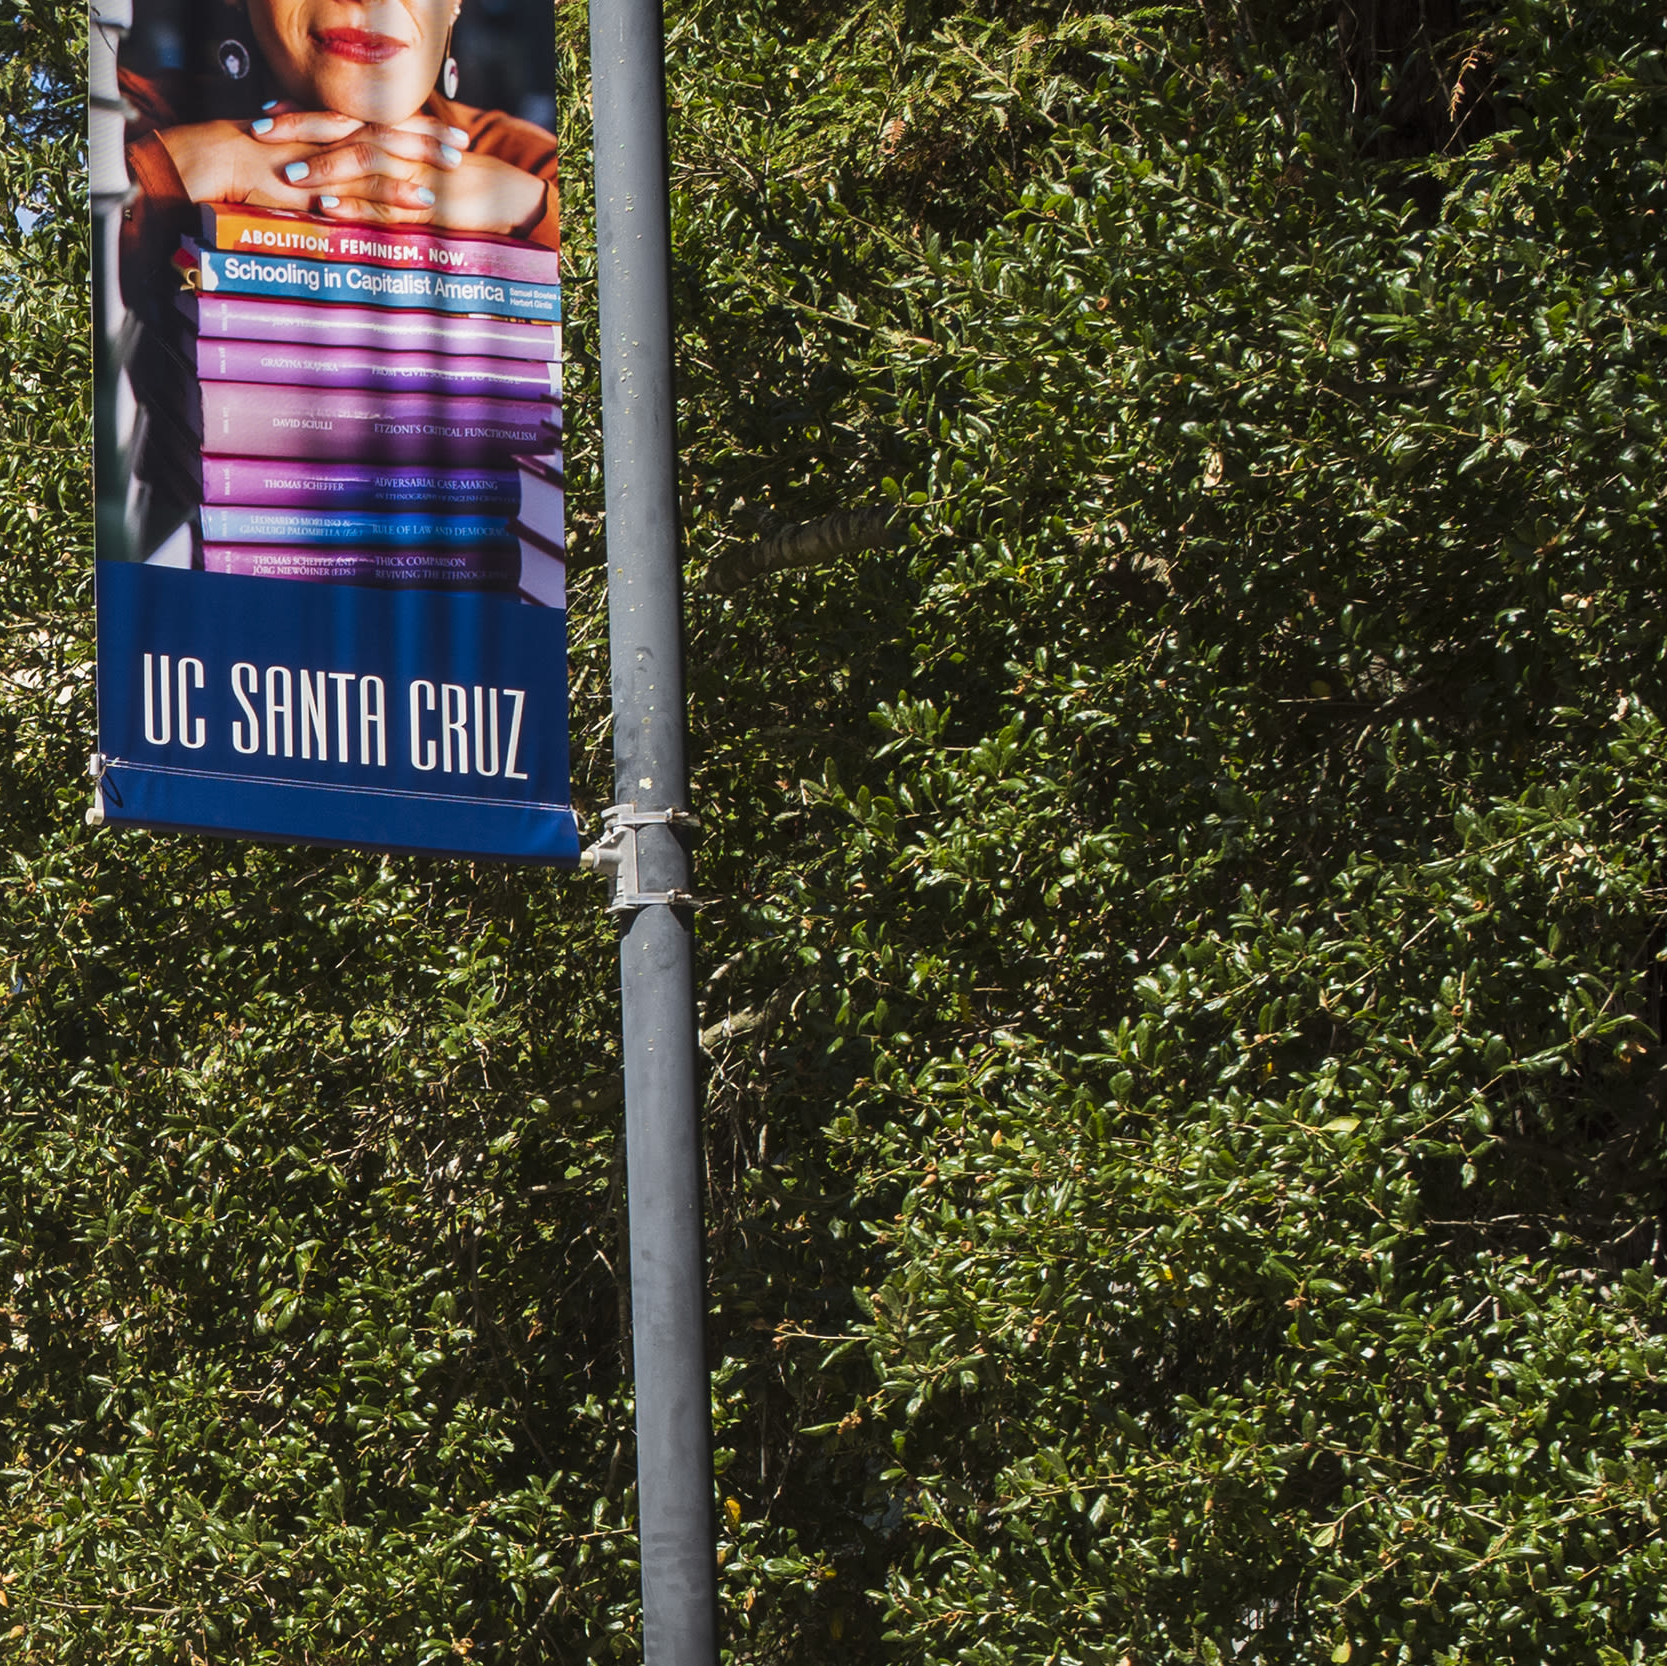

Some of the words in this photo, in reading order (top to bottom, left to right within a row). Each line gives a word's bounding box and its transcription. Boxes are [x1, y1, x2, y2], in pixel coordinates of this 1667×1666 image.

[240, 229, 334, 253] ABOLITION.
[340, 239, 423, 261] FEMINISM.
[429, 247, 468, 267] NOW.
[224, 257, 320, 291] Schooling
[324, 268, 341, 288] in
[346, 268, 431, 296] Capitalist
[434, 277, 505, 302] America
[273, 418, 300, 428] DAVID
[302, 419, 333, 430] SCIULLI
[423, 425, 462, 438] CRITICAL
[464, 427, 537, 441] FUNCTIONALISM
[264, 479, 301, 490] THOMAS
[302, 481, 345, 491] SCHEFFER
[375, 477, 436, 489] ADVERSARIAL
[372, 524, 395, 534] RULE
[396, 525, 411, 534] OF
[413, 525, 432, 535] LAW
[253, 554, 291, 565] THOMAS
[375, 556, 405, 567] THICK
[144, 653, 206, 750] UC
[231, 661, 387, 767] SANTA
[409, 679, 529, 780] CRUZ
